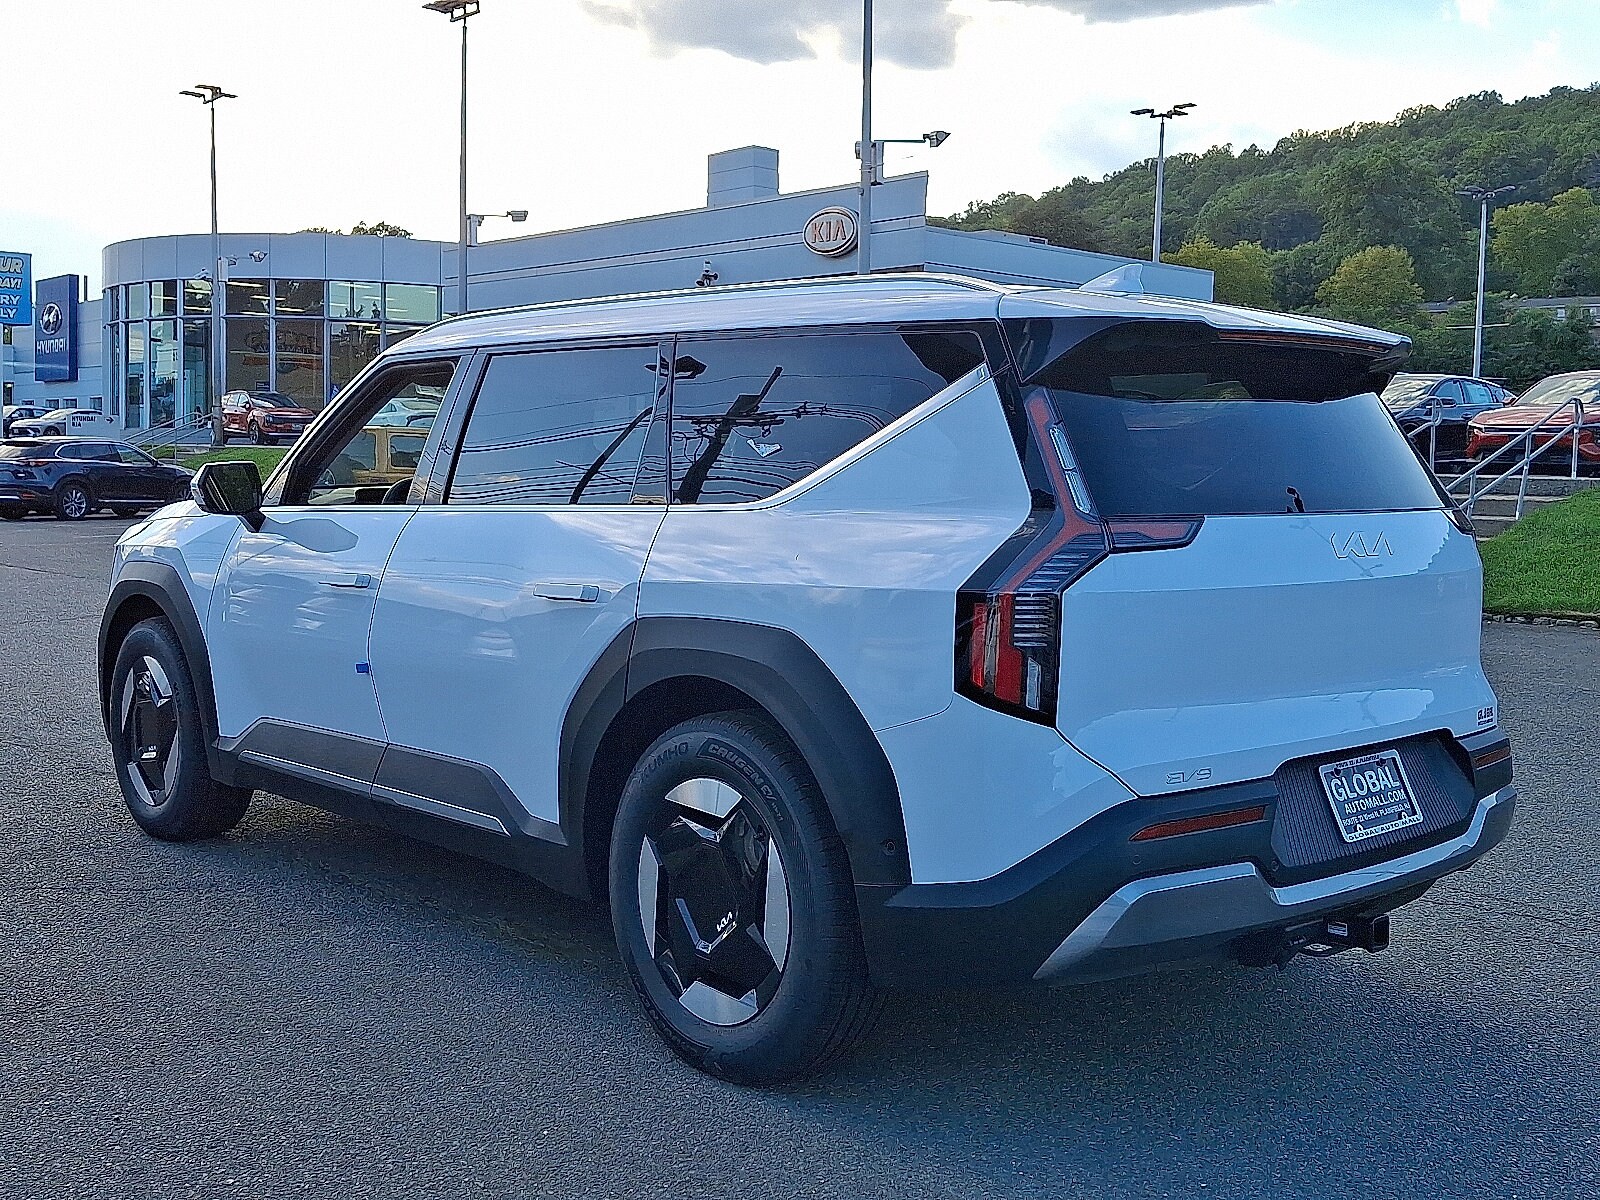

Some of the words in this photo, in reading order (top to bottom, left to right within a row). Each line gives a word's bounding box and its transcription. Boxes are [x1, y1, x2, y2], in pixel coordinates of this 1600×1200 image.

[811, 219, 847, 244] KIA
[36, 337, 67, 355] HYUNDAI
[1329, 531, 1394, 560] KIA
[1165, 767, 1213, 785] EV9
[1330, 766, 1400, 801] GLOBAL
[1344, 789, 1407, 815] AUTOMALL.COM
[1348, 828, 1378, 840] GLOBAL
[1380, 822, 1400, 833] AUTO
